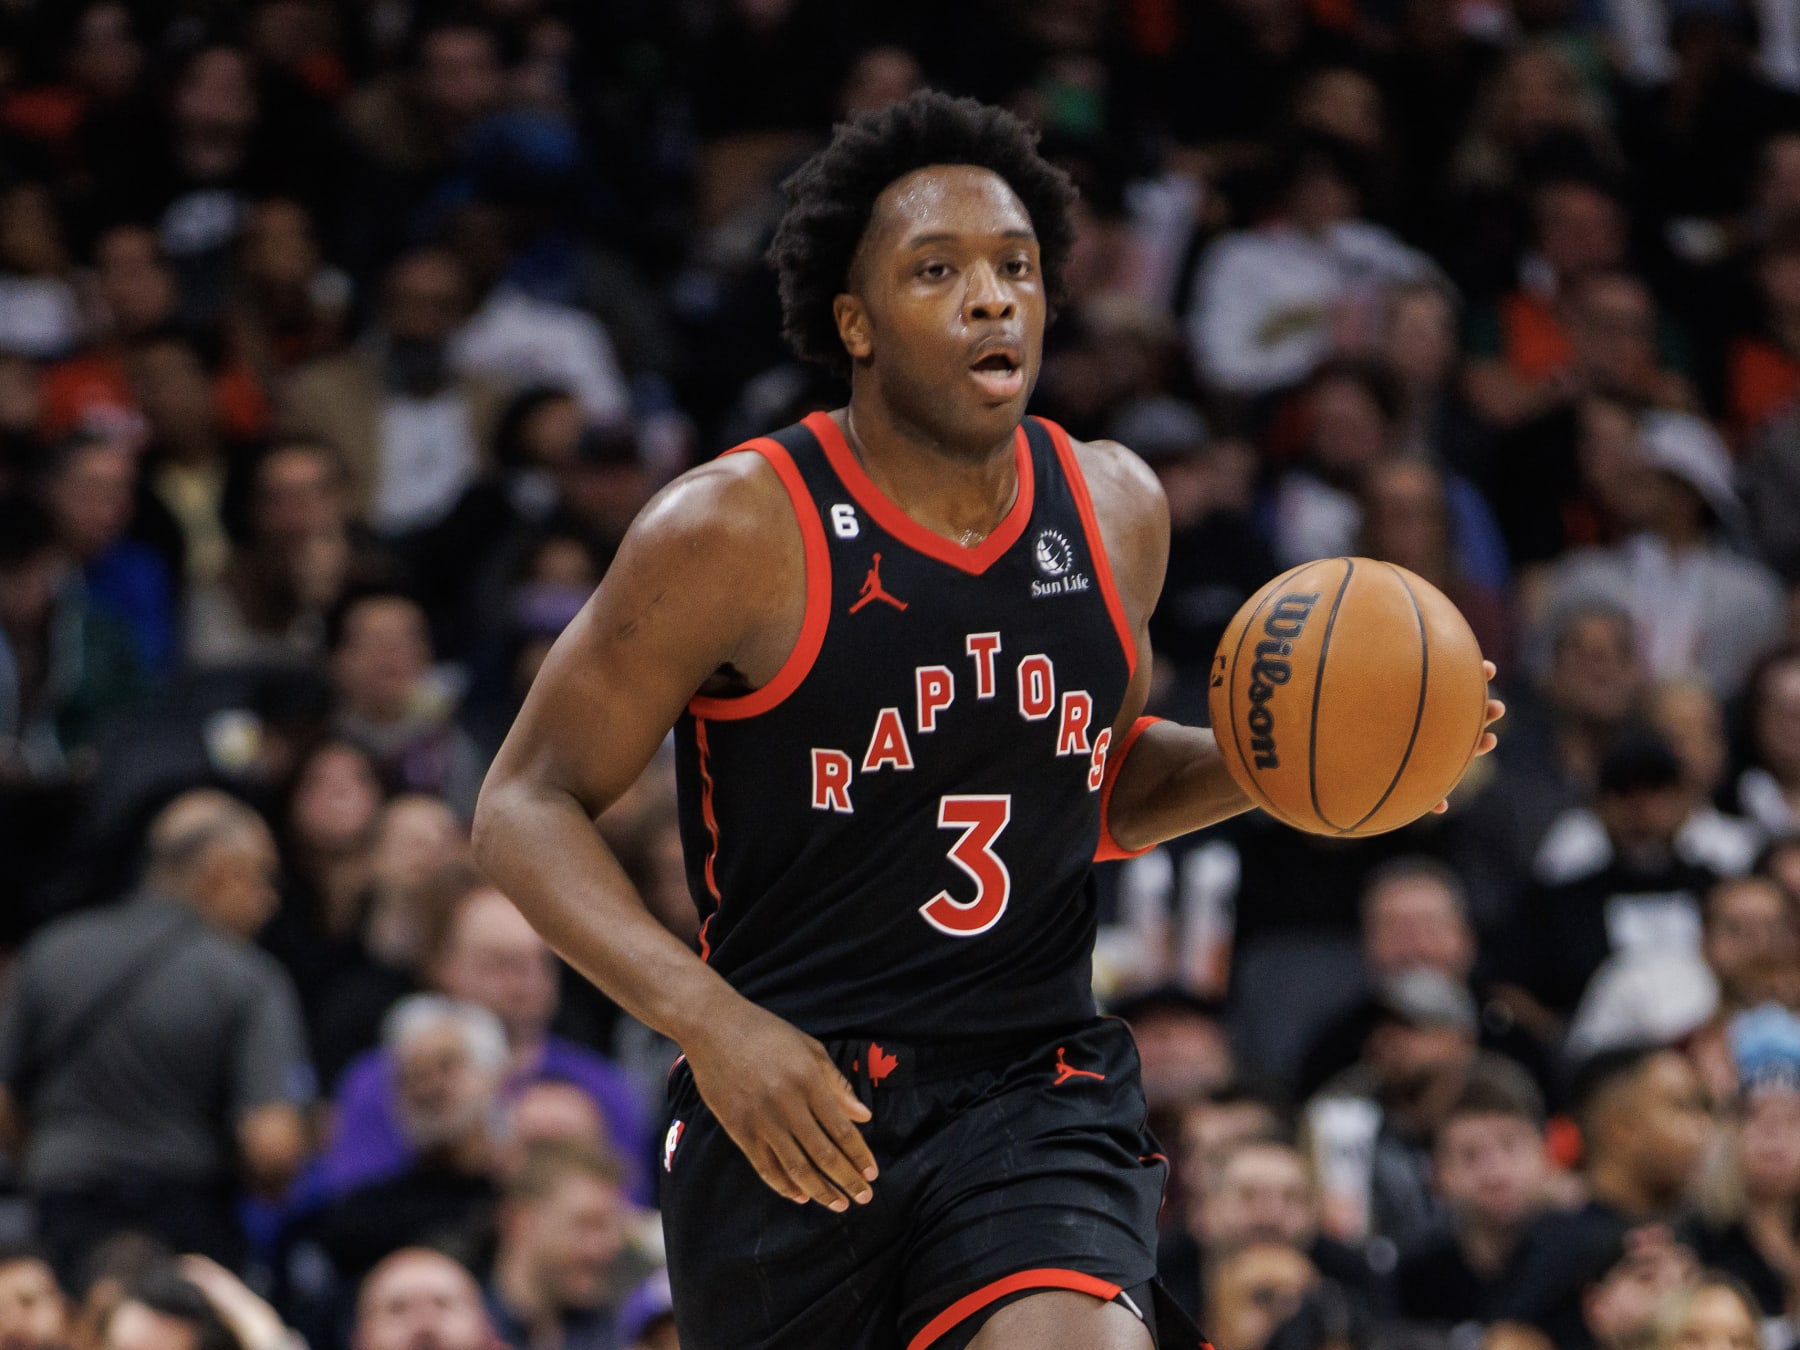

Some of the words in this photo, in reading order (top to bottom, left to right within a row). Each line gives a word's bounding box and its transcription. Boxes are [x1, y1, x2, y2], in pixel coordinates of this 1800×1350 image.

[830, 503, 860, 539] 6
[1031, 580, 1061, 597] Sun
[1063, 573, 1090, 592] Life
[811, 631, 1112, 813] RAPTORS
[1248, 592, 1321, 770] Wilson
[918, 794, 1011, 936] 3
